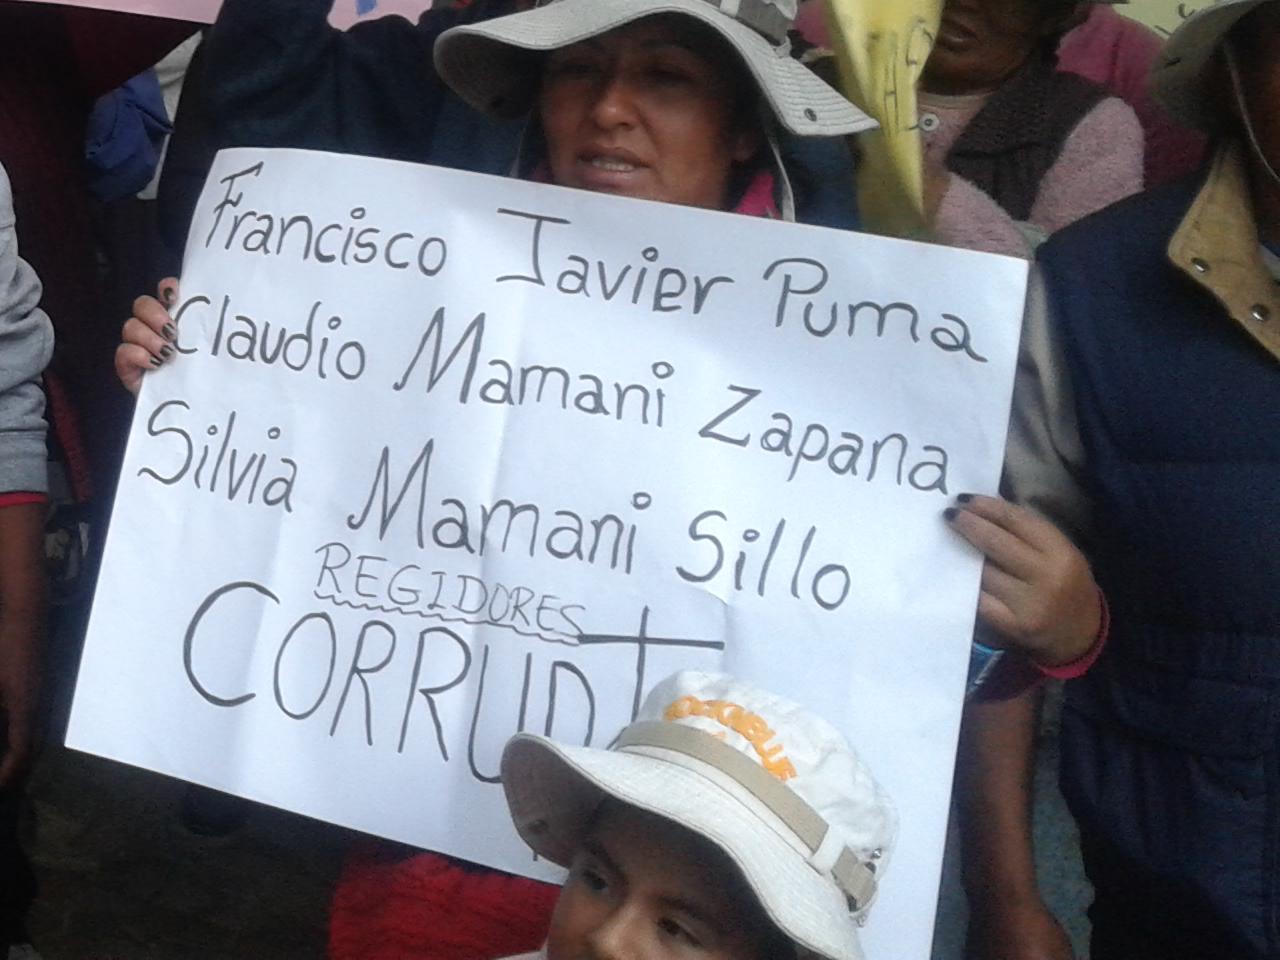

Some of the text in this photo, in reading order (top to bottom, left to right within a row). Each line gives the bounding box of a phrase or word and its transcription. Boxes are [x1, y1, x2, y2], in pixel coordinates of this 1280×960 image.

[203, 161, 989, 364] Francisco Javier Puma
[169, 293, 951, 497] Claudio Mamani Zapana
[136, 399, 852, 612] Silvia Mamani Sillo
[314, 542, 588, 640] REGIDORES
